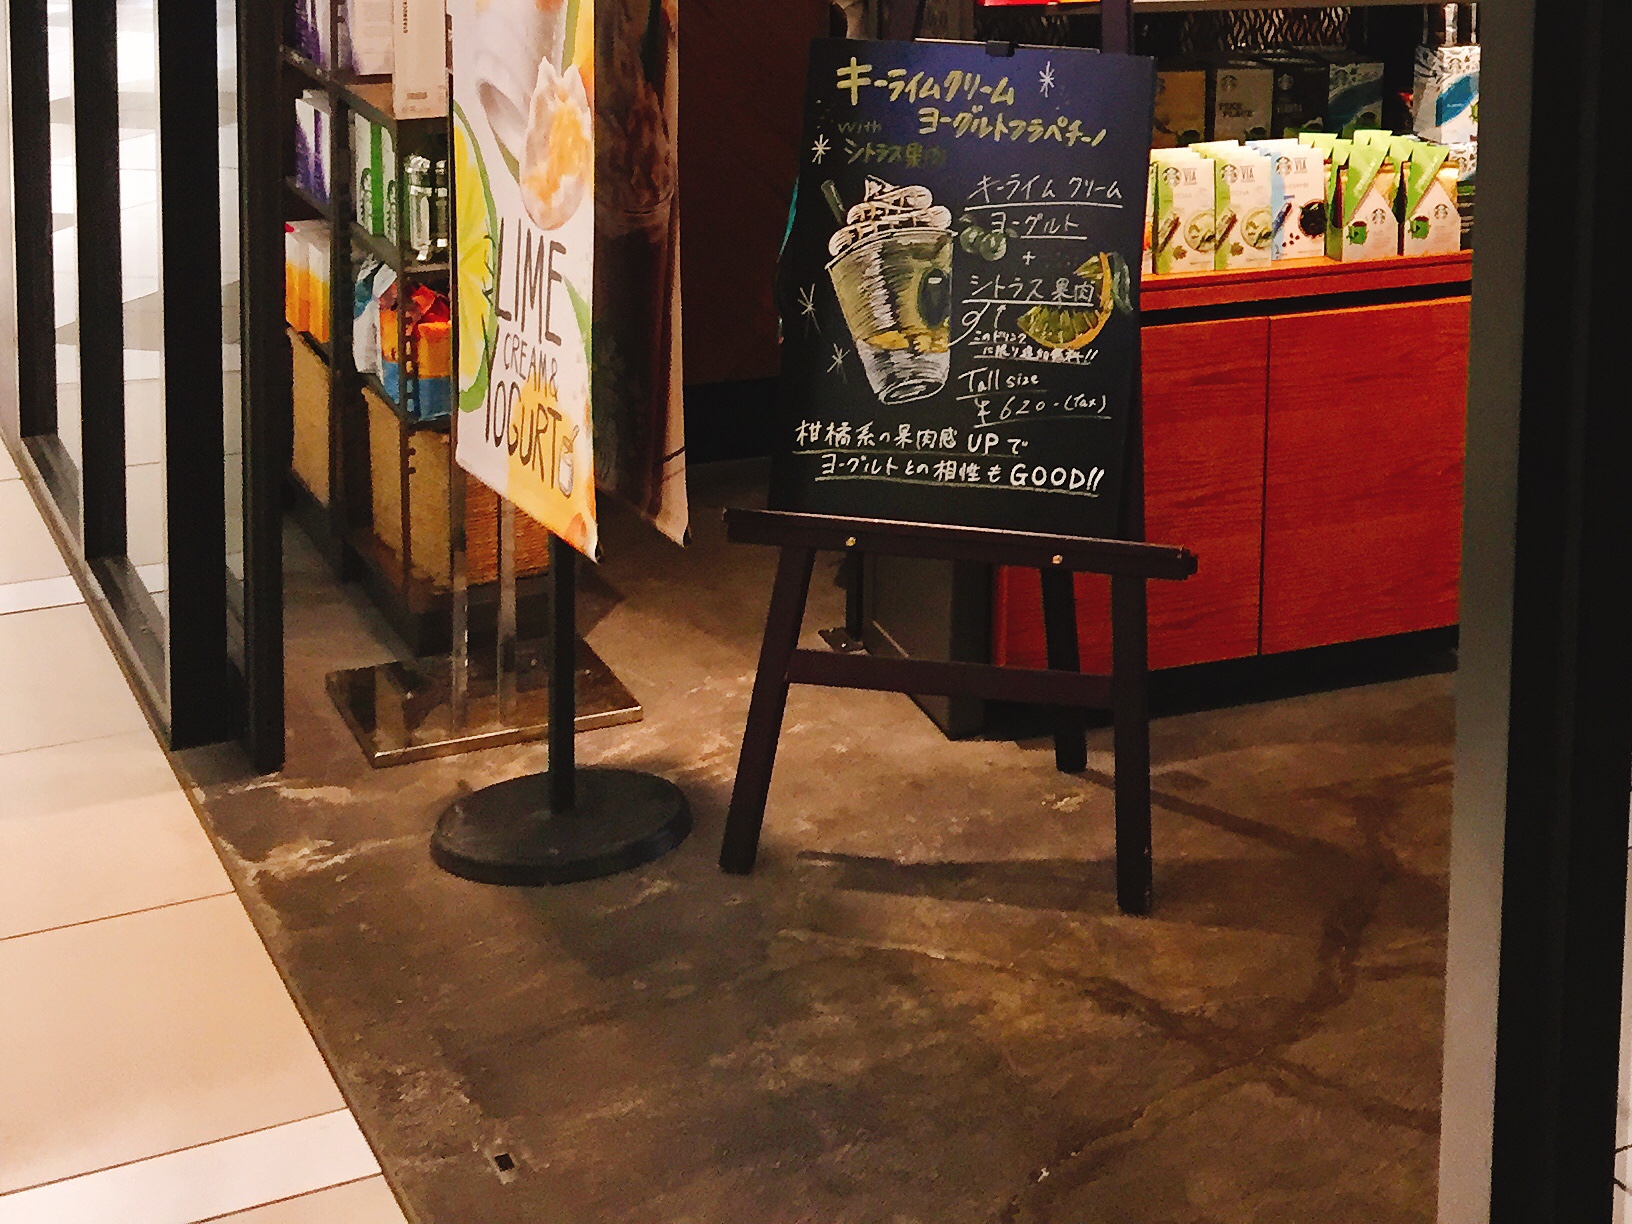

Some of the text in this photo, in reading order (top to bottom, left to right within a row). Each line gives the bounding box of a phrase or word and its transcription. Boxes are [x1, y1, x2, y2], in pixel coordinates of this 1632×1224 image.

[837, 56, 1014, 105] キーライムクリーム
[918, 104, 1107, 147] ヨーグルトフラペチーノ
[991, 212, 1079, 236] ヨーグルト
[495, 217, 567, 346] LIME
[958, 367, 1039, 392] Tall size
[481, 313, 562, 489] YOGURT
[967, 432, 999, 455] UP
[1009, 463, 1105, 492] GOOD!!
